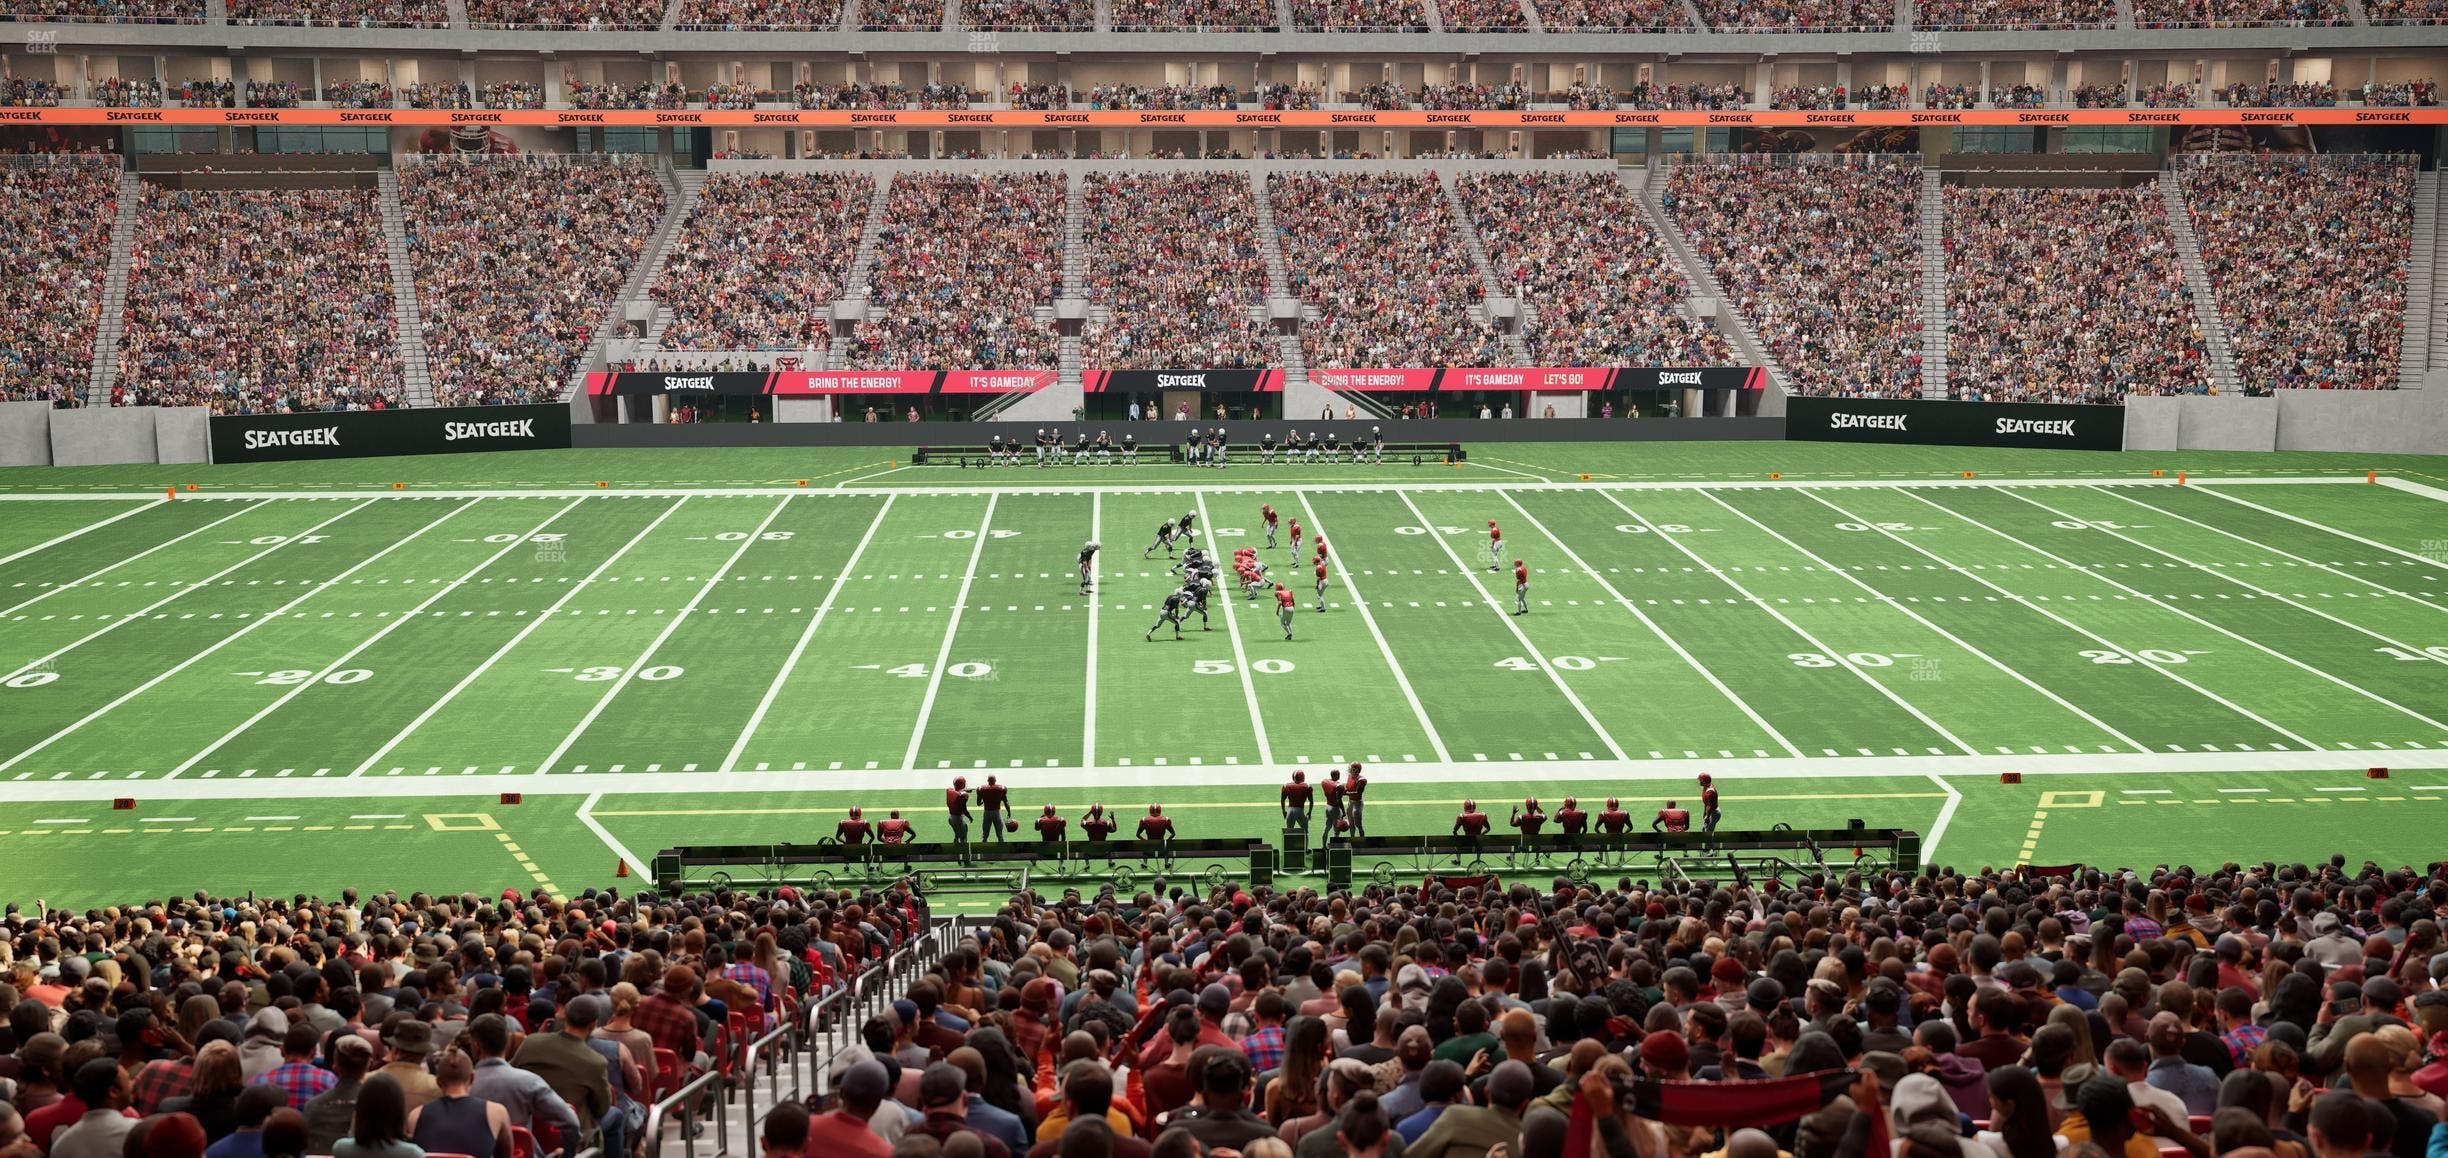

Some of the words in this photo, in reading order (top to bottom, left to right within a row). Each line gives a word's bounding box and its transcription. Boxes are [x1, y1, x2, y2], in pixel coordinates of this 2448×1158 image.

[106, 111, 163, 120] SEATGEEK
[225, 112, 279, 121] SEATGEEK
[340, 112, 392, 121] SEATGEEK
[451, 113, 501, 121] SEATGEEK
[558, 113, 604, 122] SEATGEEK
[656, 113, 701, 122] SEATGEEK
[754, 113, 799, 122] SEATGEEK
[851, 113, 896, 122] SEATGEEK
[948, 114, 993, 122] SEATGEEK
[1044, 114, 1089, 122] SEATGEEK
[1140, 114, 1185, 122] SEATGEEK
[1236, 114, 1281, 122] SEATGEEK
[1331, 114, 1376, 122] SEATGEEK
[1426, 114, 1471, 122] SEATGEEK
[1521, 114, 1565, 122] SEATGEEK
[1615, 114, 1659, 122] SEATGEEK
[1709, 114, 1753, 122] SEATGEEK
[1806, 114, 1855, 122] SEATGEEK
[1911, 113, 1961, 122] SEATGEEK
[2019, 113, 2070, 122] SEATGEEK
[2128, 113, 2181, 121] SEATGEEK
[2240, 112, 2294, 121] SEATGEEK
[2355, 112, 2410, 121] SEATGEEK
[664, 376, 715, 390] SEATGEEK
[808, 377, 839, 388] BRING
[841, 377, 859, 388] THE
[861, 377, 901, 388] ENERGY!
[970, 376, 988, 388] IT'S
[990, 376, 1036, 388] GAMEDAY
[1157, 374, 1207, 388] SEATGEEK
[1350, 375, 1367, 386] THE
[1367, 374, 1405, 386] ENERGY!
[1465, 374, 1482, 385] IT'S
[1483, 374, 1525, 385] GAMEDAY
[1543, 373, 1567, 385] LET'S
[1568, 373, 1584, 385] GO!
[1658, 371, 1703, 386] SEATGEEK
[1830, 412, 1908, 431] SEATGEEK
[445, 418, 535, 442] SEATGEEK
[1995, 417, 2076, 436] SEATGEEK
[244, 425, 340, 449] SEATGEEK
[1787, 652, 1895, 668] 30
[2078, 648, 2189, 664] 20
[1192, 658, 1297, 674] 50
[1493, 655, 1598, 671] 40
[573, 665, 685, 681] 30
[886, 662, 992, 678] 40
[255, 669, 374, 685] 20
